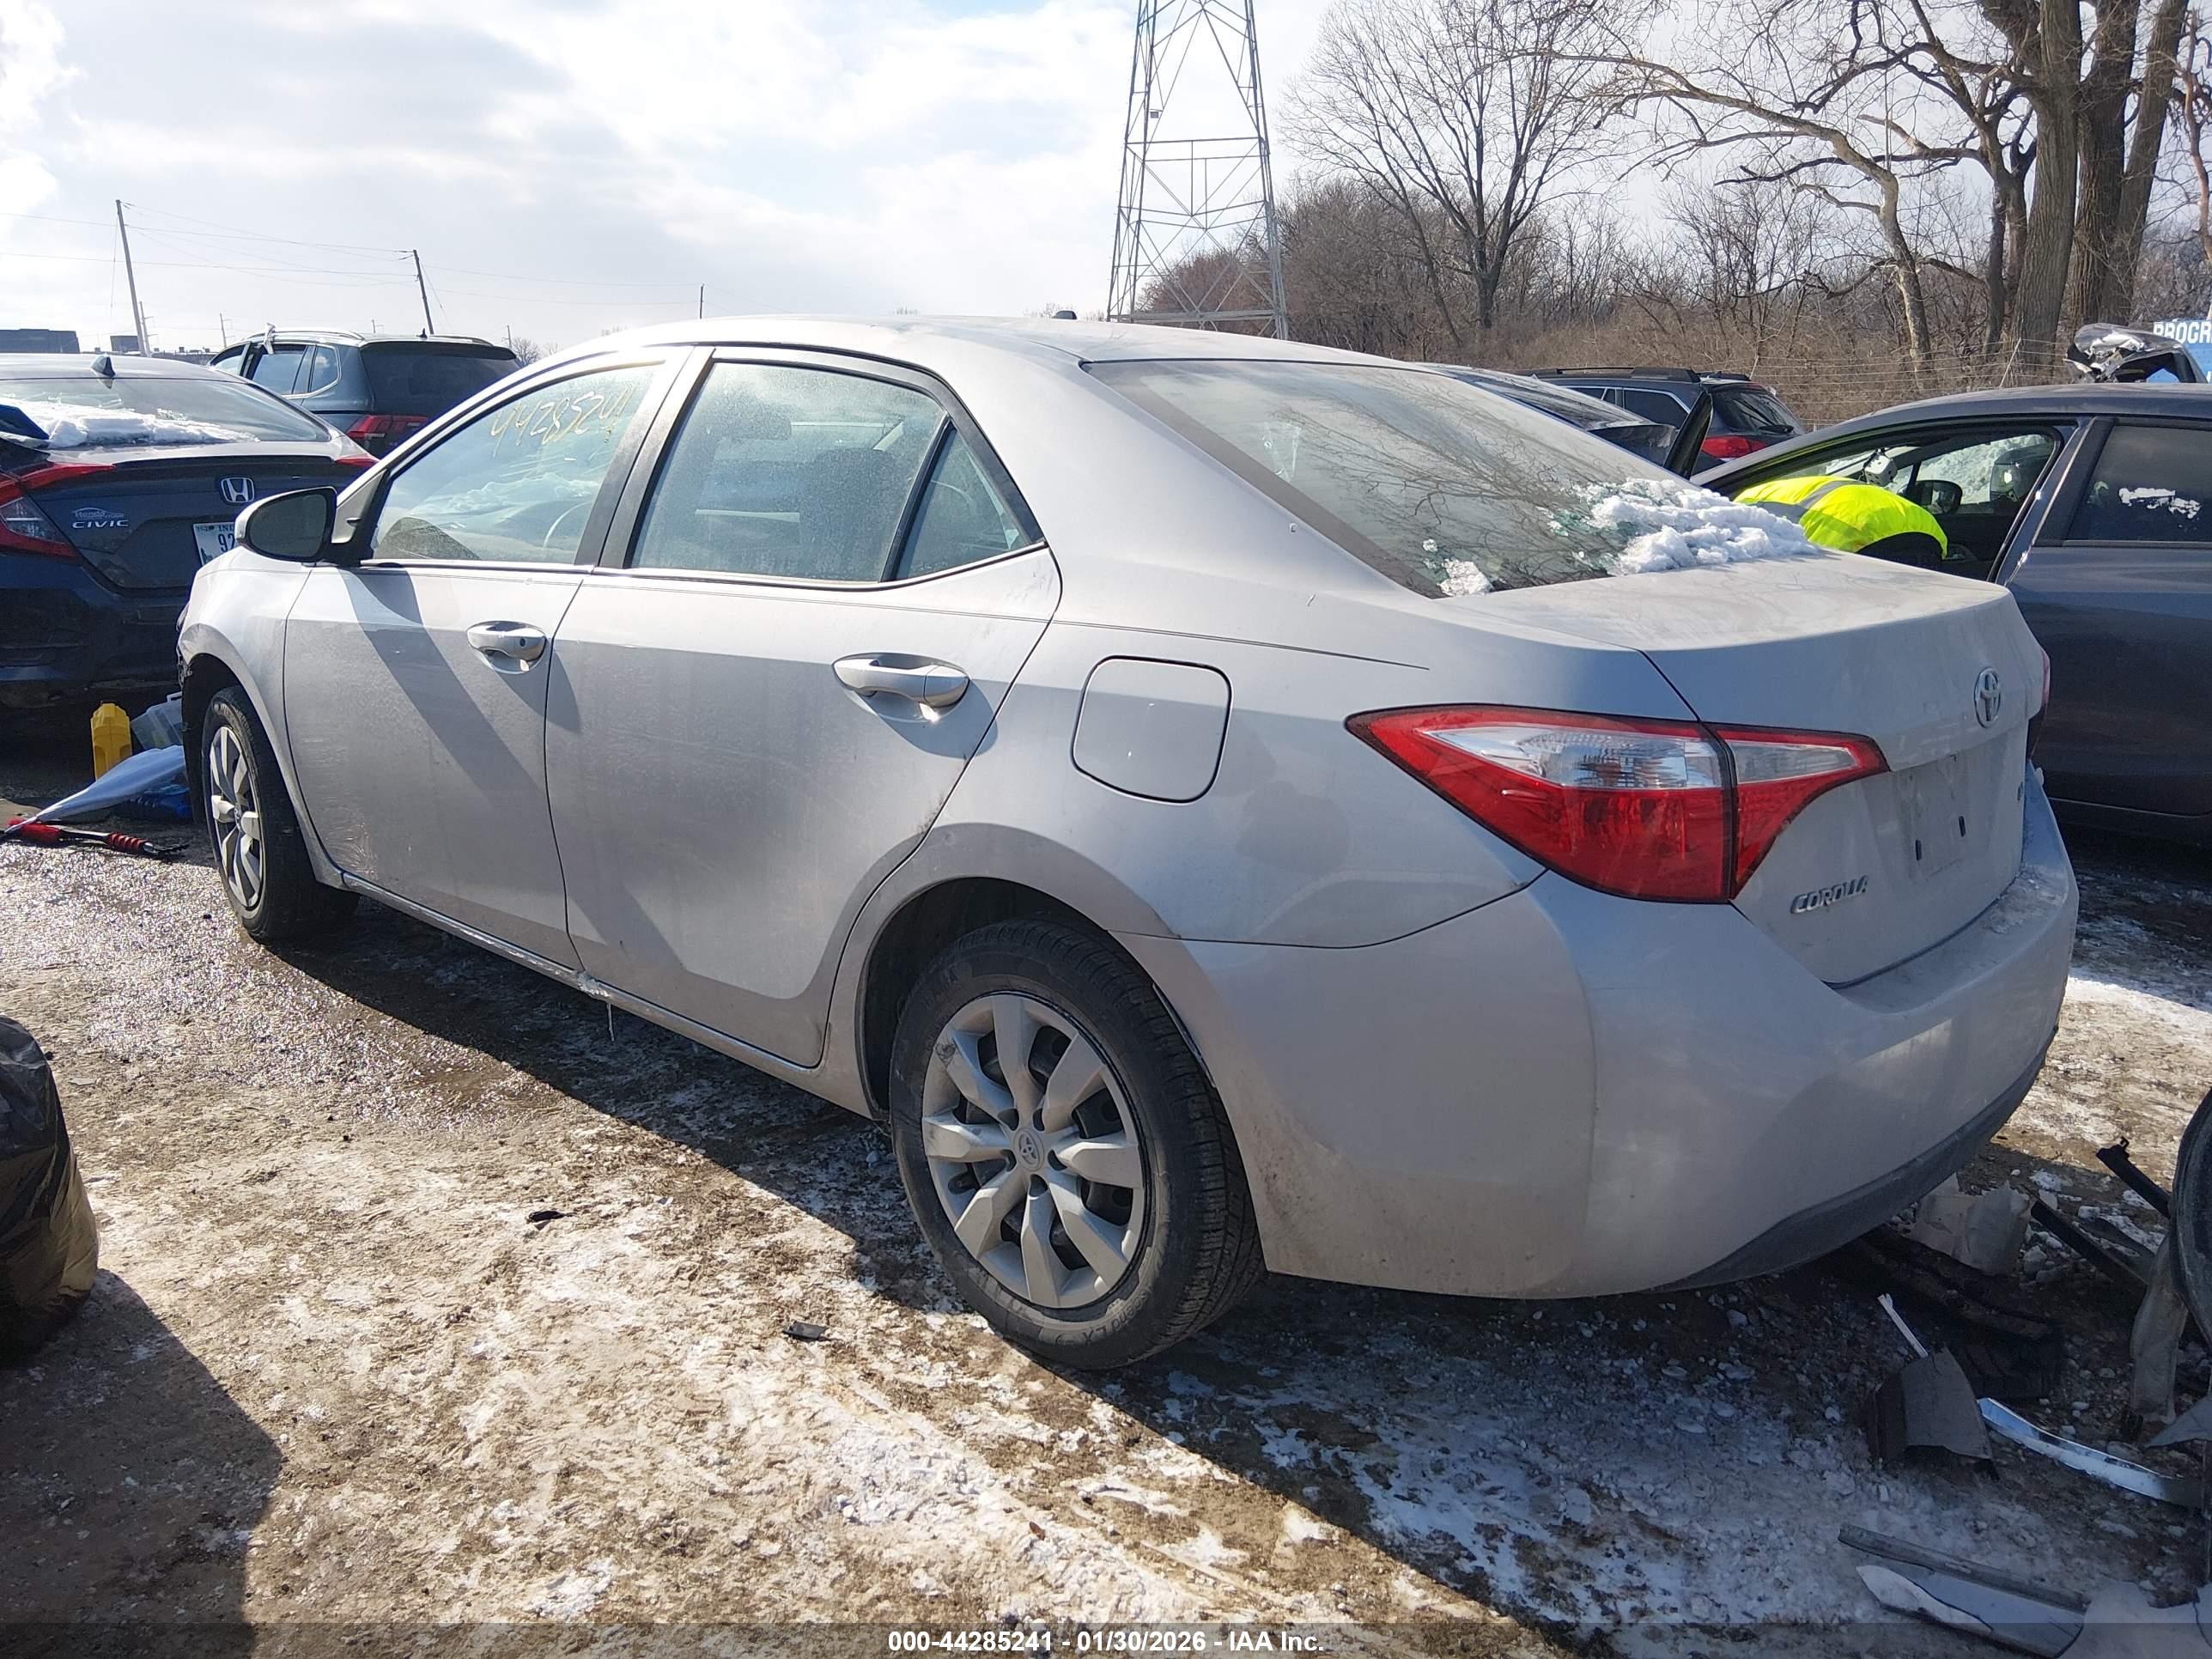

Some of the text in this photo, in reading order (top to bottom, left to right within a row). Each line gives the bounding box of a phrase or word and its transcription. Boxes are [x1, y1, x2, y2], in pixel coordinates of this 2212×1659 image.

[489, 384, 636, 459] 44285241
[71, 520, 130, 529] CIVIC
[1790, 874, 1870, 915] COROLLA
